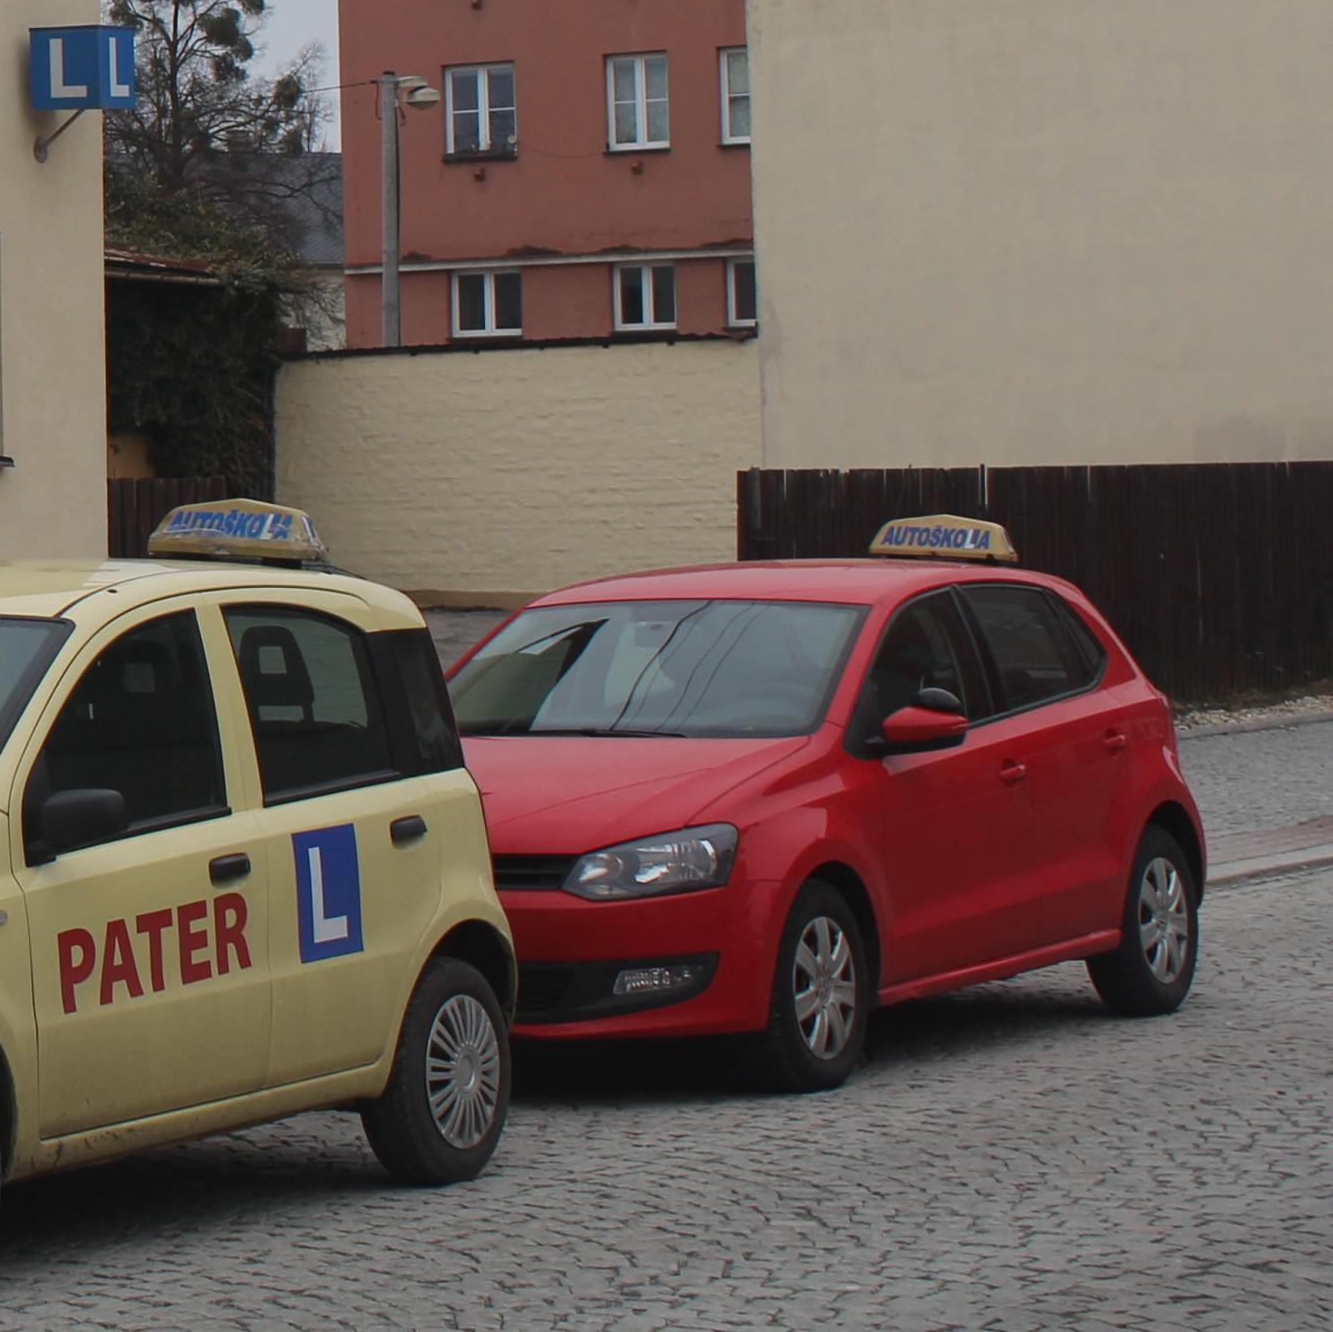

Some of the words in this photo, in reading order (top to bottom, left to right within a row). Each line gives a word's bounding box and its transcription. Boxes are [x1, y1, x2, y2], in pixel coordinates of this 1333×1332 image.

[49, 38, 87, 99] L
[109, 37, 130, 97] L
[881, 525, 991, 549] AUTOŠKOLA
[308, 846, 348, 944] L
[56, 891, 253, 1015] PATER
